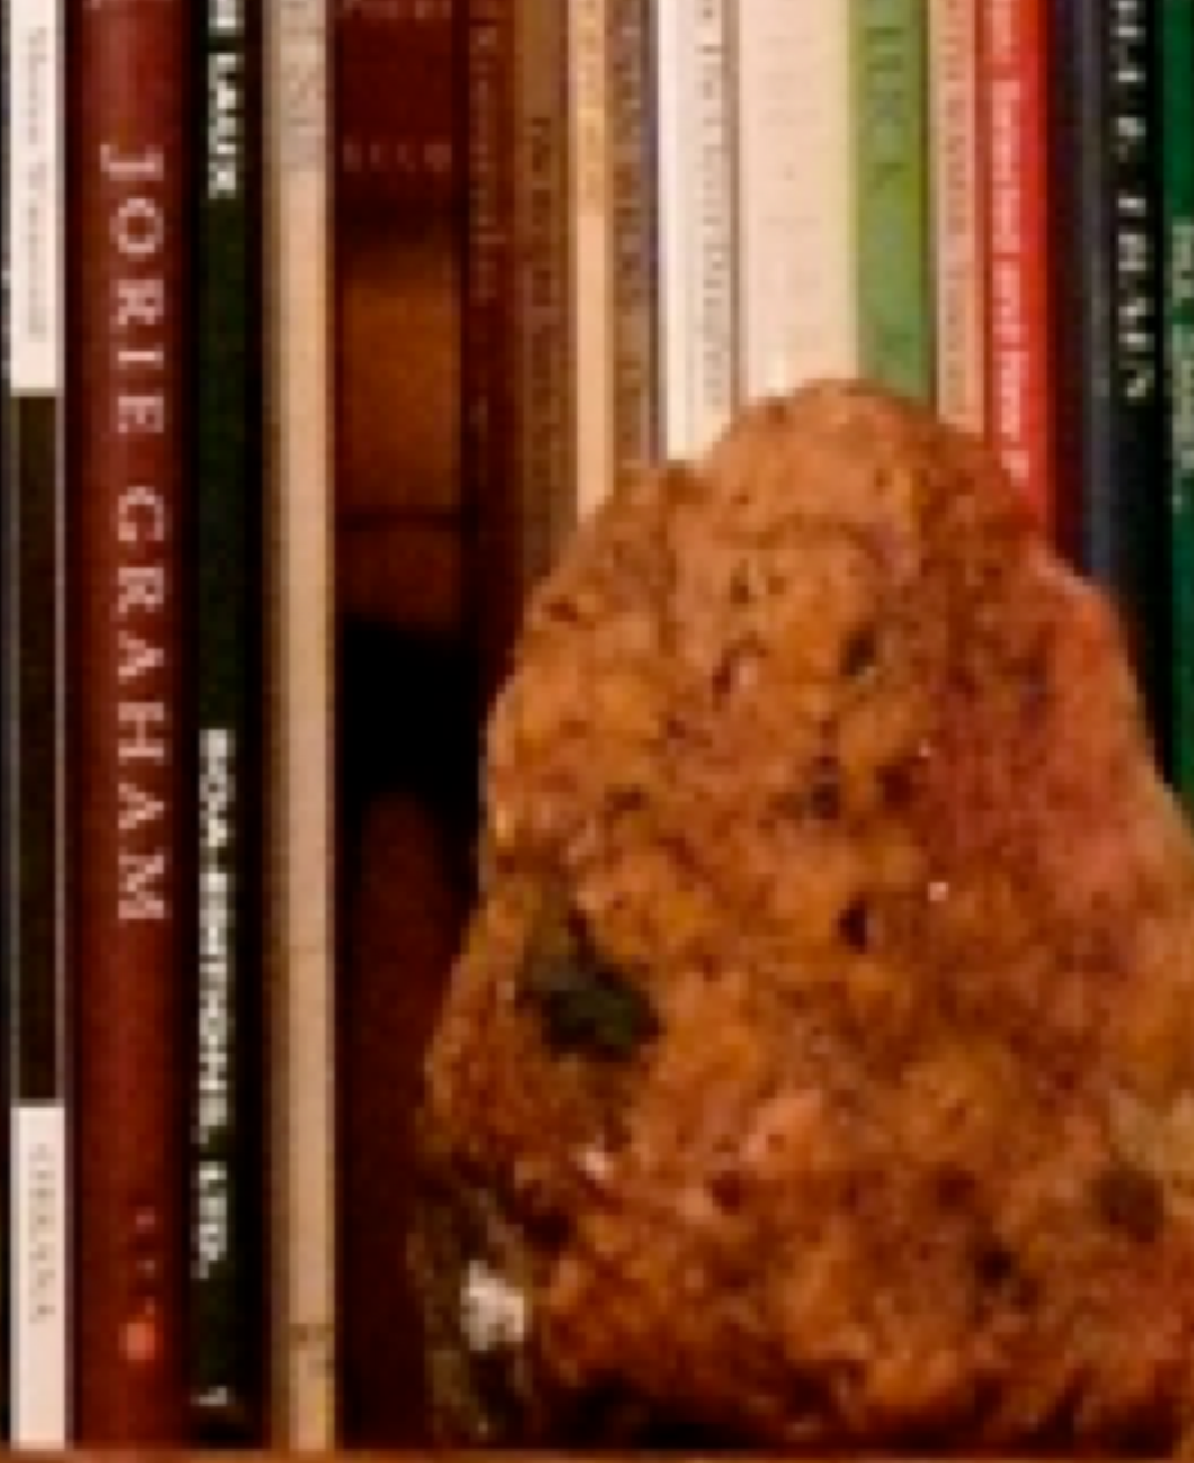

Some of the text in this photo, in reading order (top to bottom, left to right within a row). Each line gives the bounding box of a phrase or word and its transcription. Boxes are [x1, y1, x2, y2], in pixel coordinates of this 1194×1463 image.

[206, 51, 243, 197] LAUX
[990, 78, 1025, 255] Selected
[100, 143, 168, 439] JORIE
[993, 260, 1030, 342] and
[996, 349, 1031, 442] New
[114, 487, 170, 927] GRAHAM
